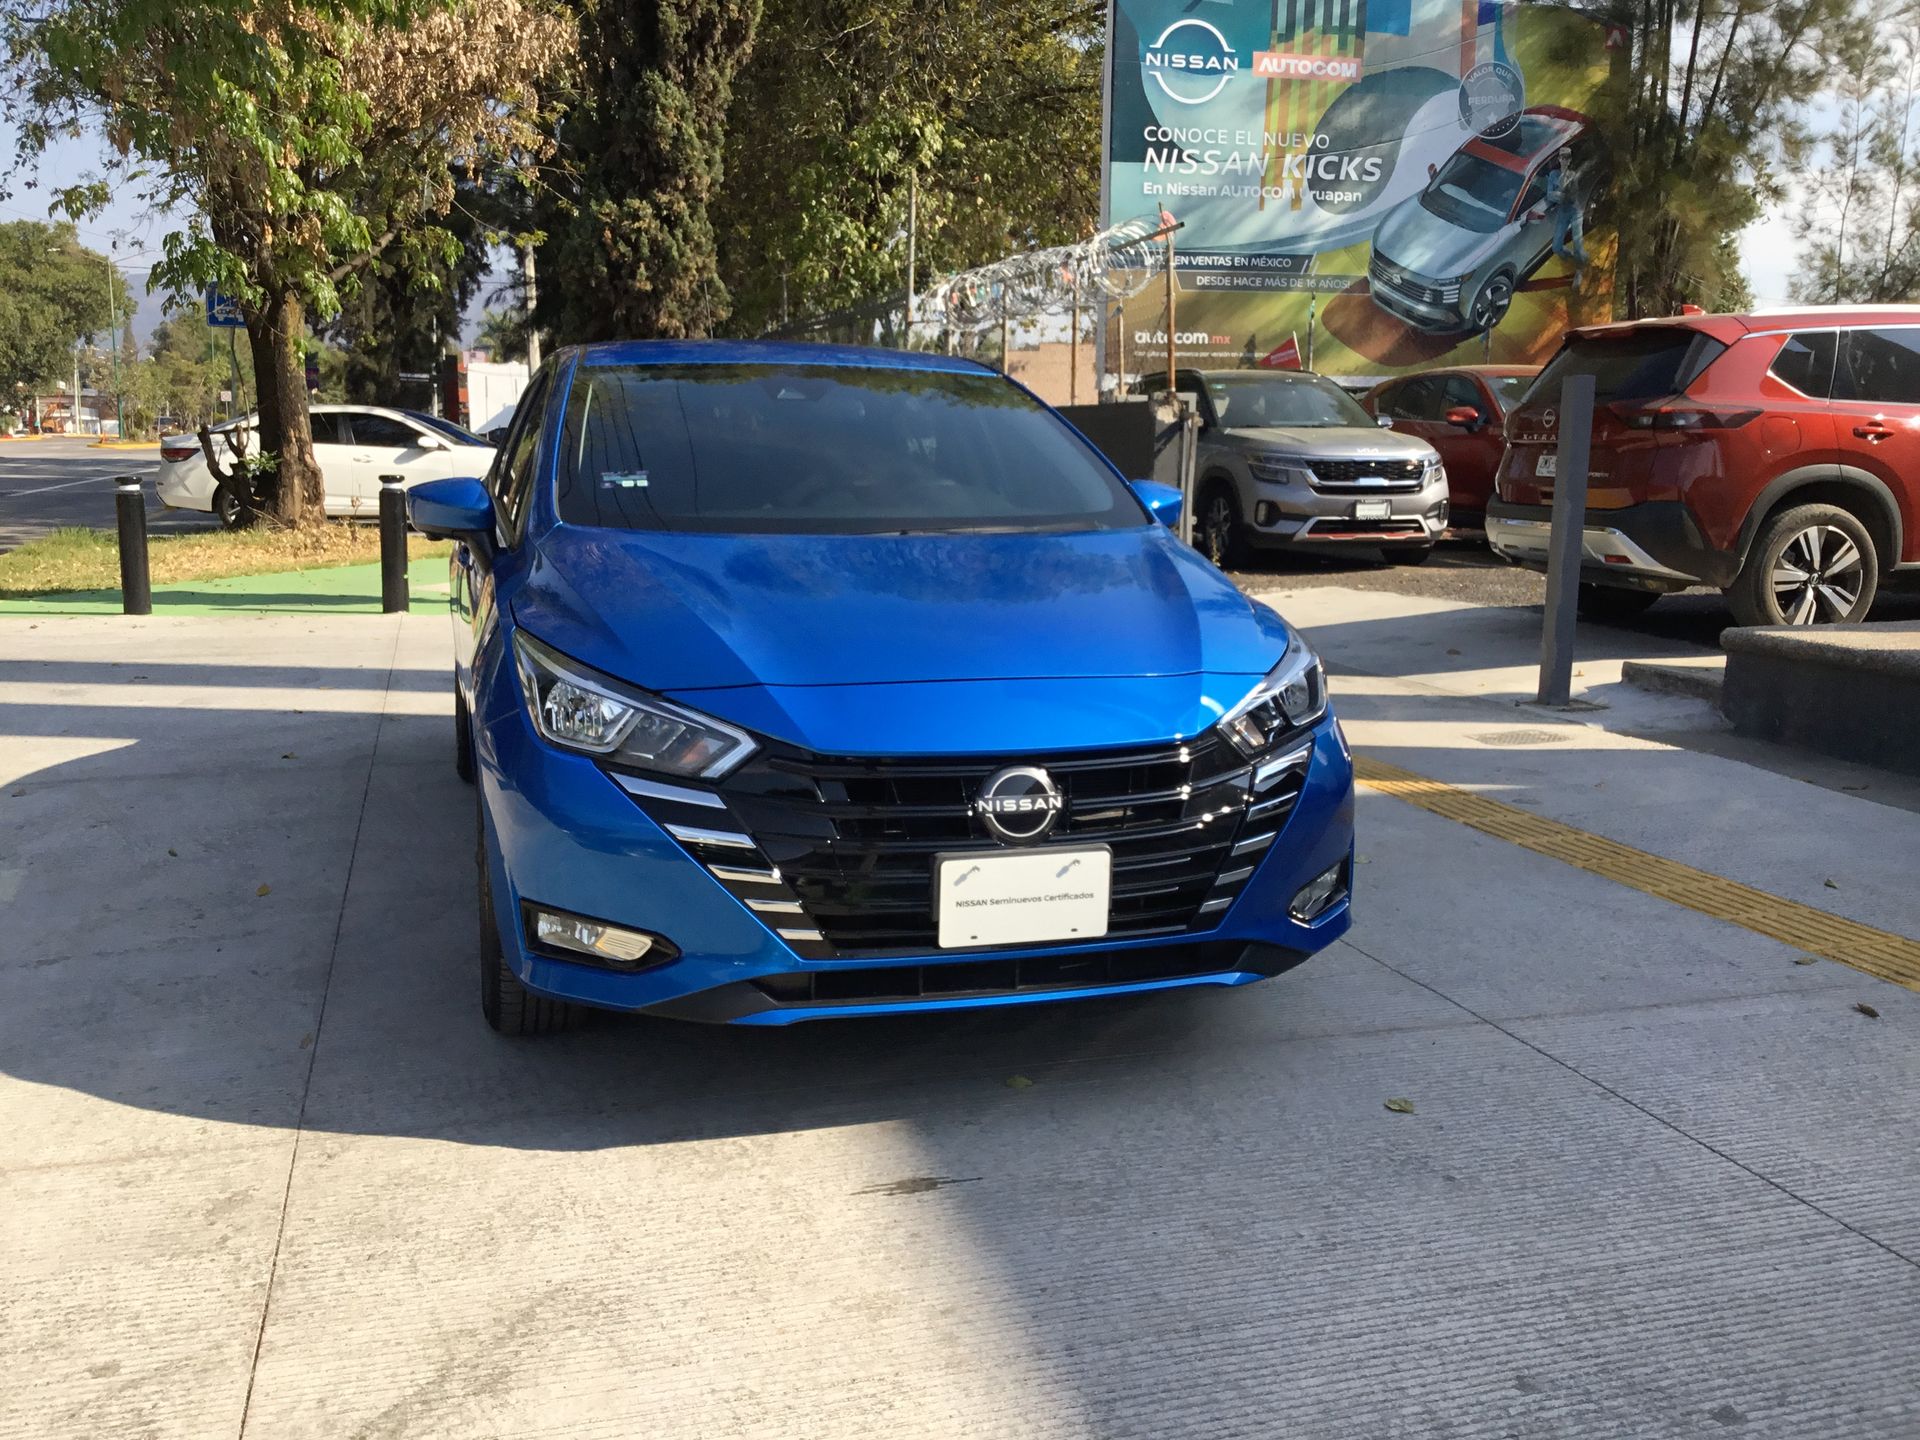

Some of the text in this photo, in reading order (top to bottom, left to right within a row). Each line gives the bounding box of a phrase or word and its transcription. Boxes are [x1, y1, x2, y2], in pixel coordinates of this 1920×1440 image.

[1145, 52, 1239, 71] NISSAN
[1258, 57, 1357, 78] AUTOCOM
[1468, 66, 1513, 83] VALOR QUE
[1468, 94, 1516, 105] PERDURA
[1143, 126, 1330, 150] CONOCE EL NUEVO
[1143, 147, 1384, 182] NISSAN KICKS
[1143, 182, 1163, 195] En
[1166, 182, 1217, 197] Nissan
[1220, 184, 1296, 199] AUTOCOM
[1174, 255, 1189, 265] EN
[1190, 256, 1232, 266] VENTAS
[1234, 257, 1249, 267] EN
[1250, 255, 1292, 268] MÉXICO
[1196, 275, 1232, 286] DESDE
[1233, 276, 1262, 287] HACE
[1264, 274, 1288, 287] MÁS
[1289, 278, 1304, 288] DE
[1306, 278, 1317, 288] 16
[978, 796, 1062, 812] NISSAN
[955, 892, 1095, 908] NISSAN Seminuevos Certificados
